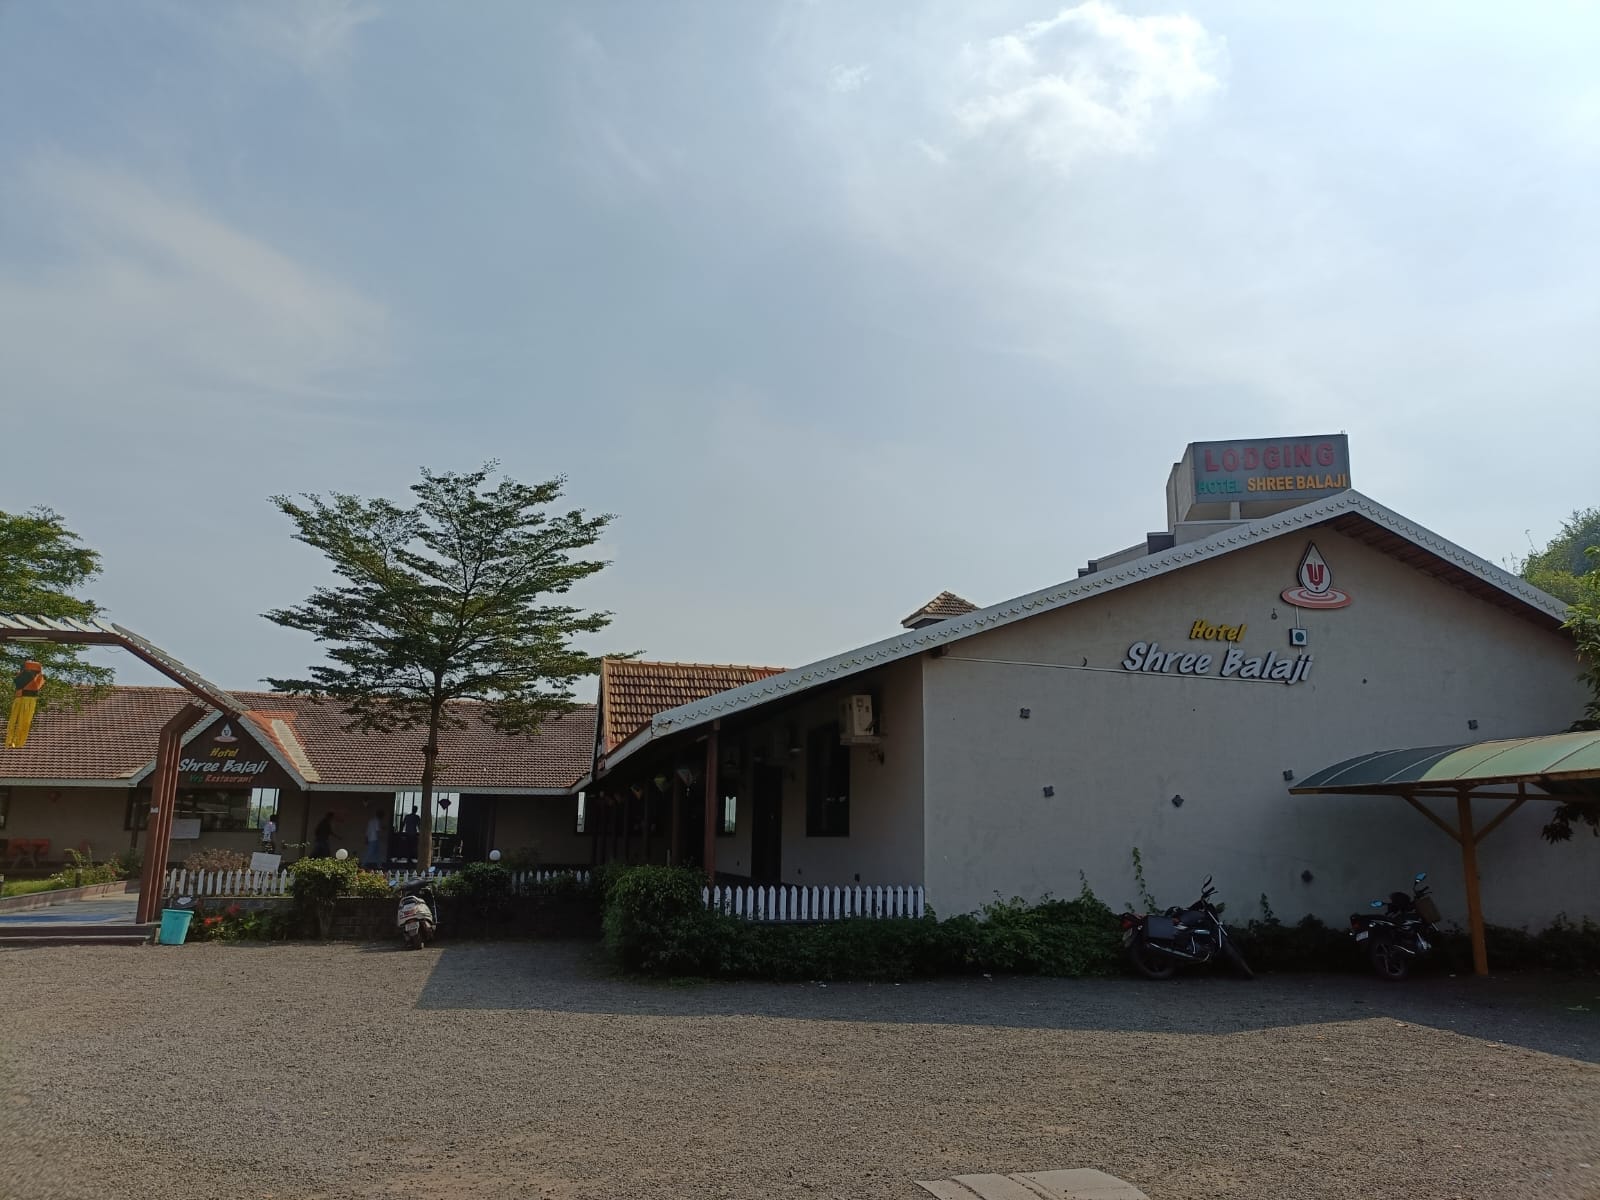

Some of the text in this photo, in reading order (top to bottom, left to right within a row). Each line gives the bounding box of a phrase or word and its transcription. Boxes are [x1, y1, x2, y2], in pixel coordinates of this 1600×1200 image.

[1204, 443, 1334, 472] LODGING
[1198, 473, 1347, 494] HOTEL SHREE BALAJI
[1190, 620, 1247, 642] Hotel
[1123, 641, 1314, 685] Shree Balaji
[210, 748, 239, 757] Hotel
[178, 759, 269, 774] Shree Balaji
